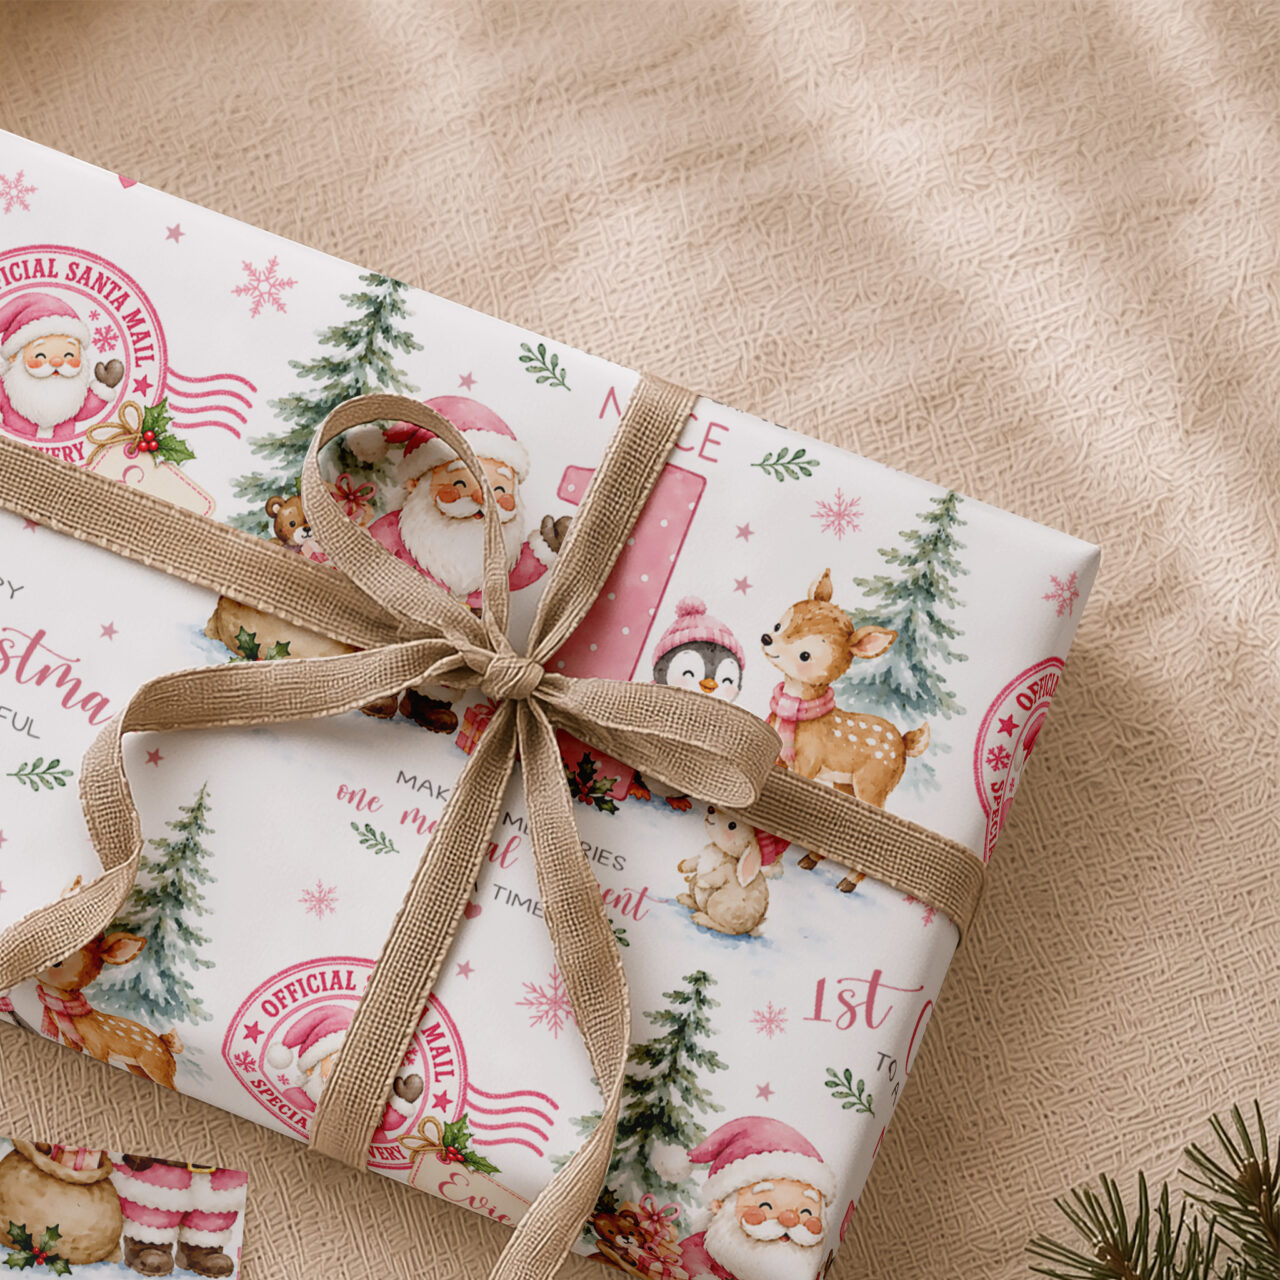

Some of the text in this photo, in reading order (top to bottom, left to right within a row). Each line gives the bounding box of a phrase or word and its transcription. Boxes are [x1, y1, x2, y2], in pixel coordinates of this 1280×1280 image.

[65, 261, 131, 312] SANTA
[122, 307, 155, 368] MAIL
[336, 784, 384, 813] one
[396, 770, 450, 803] MAK
[493, 884, 544, 919] TIME
[261, 970, 357, 1018] OFFICIAL
[421, 1022, 456, 1083] MAIL
[803, 969, 924, 1031] 1st
[250, 1078, 310, 1131] SPECIA
